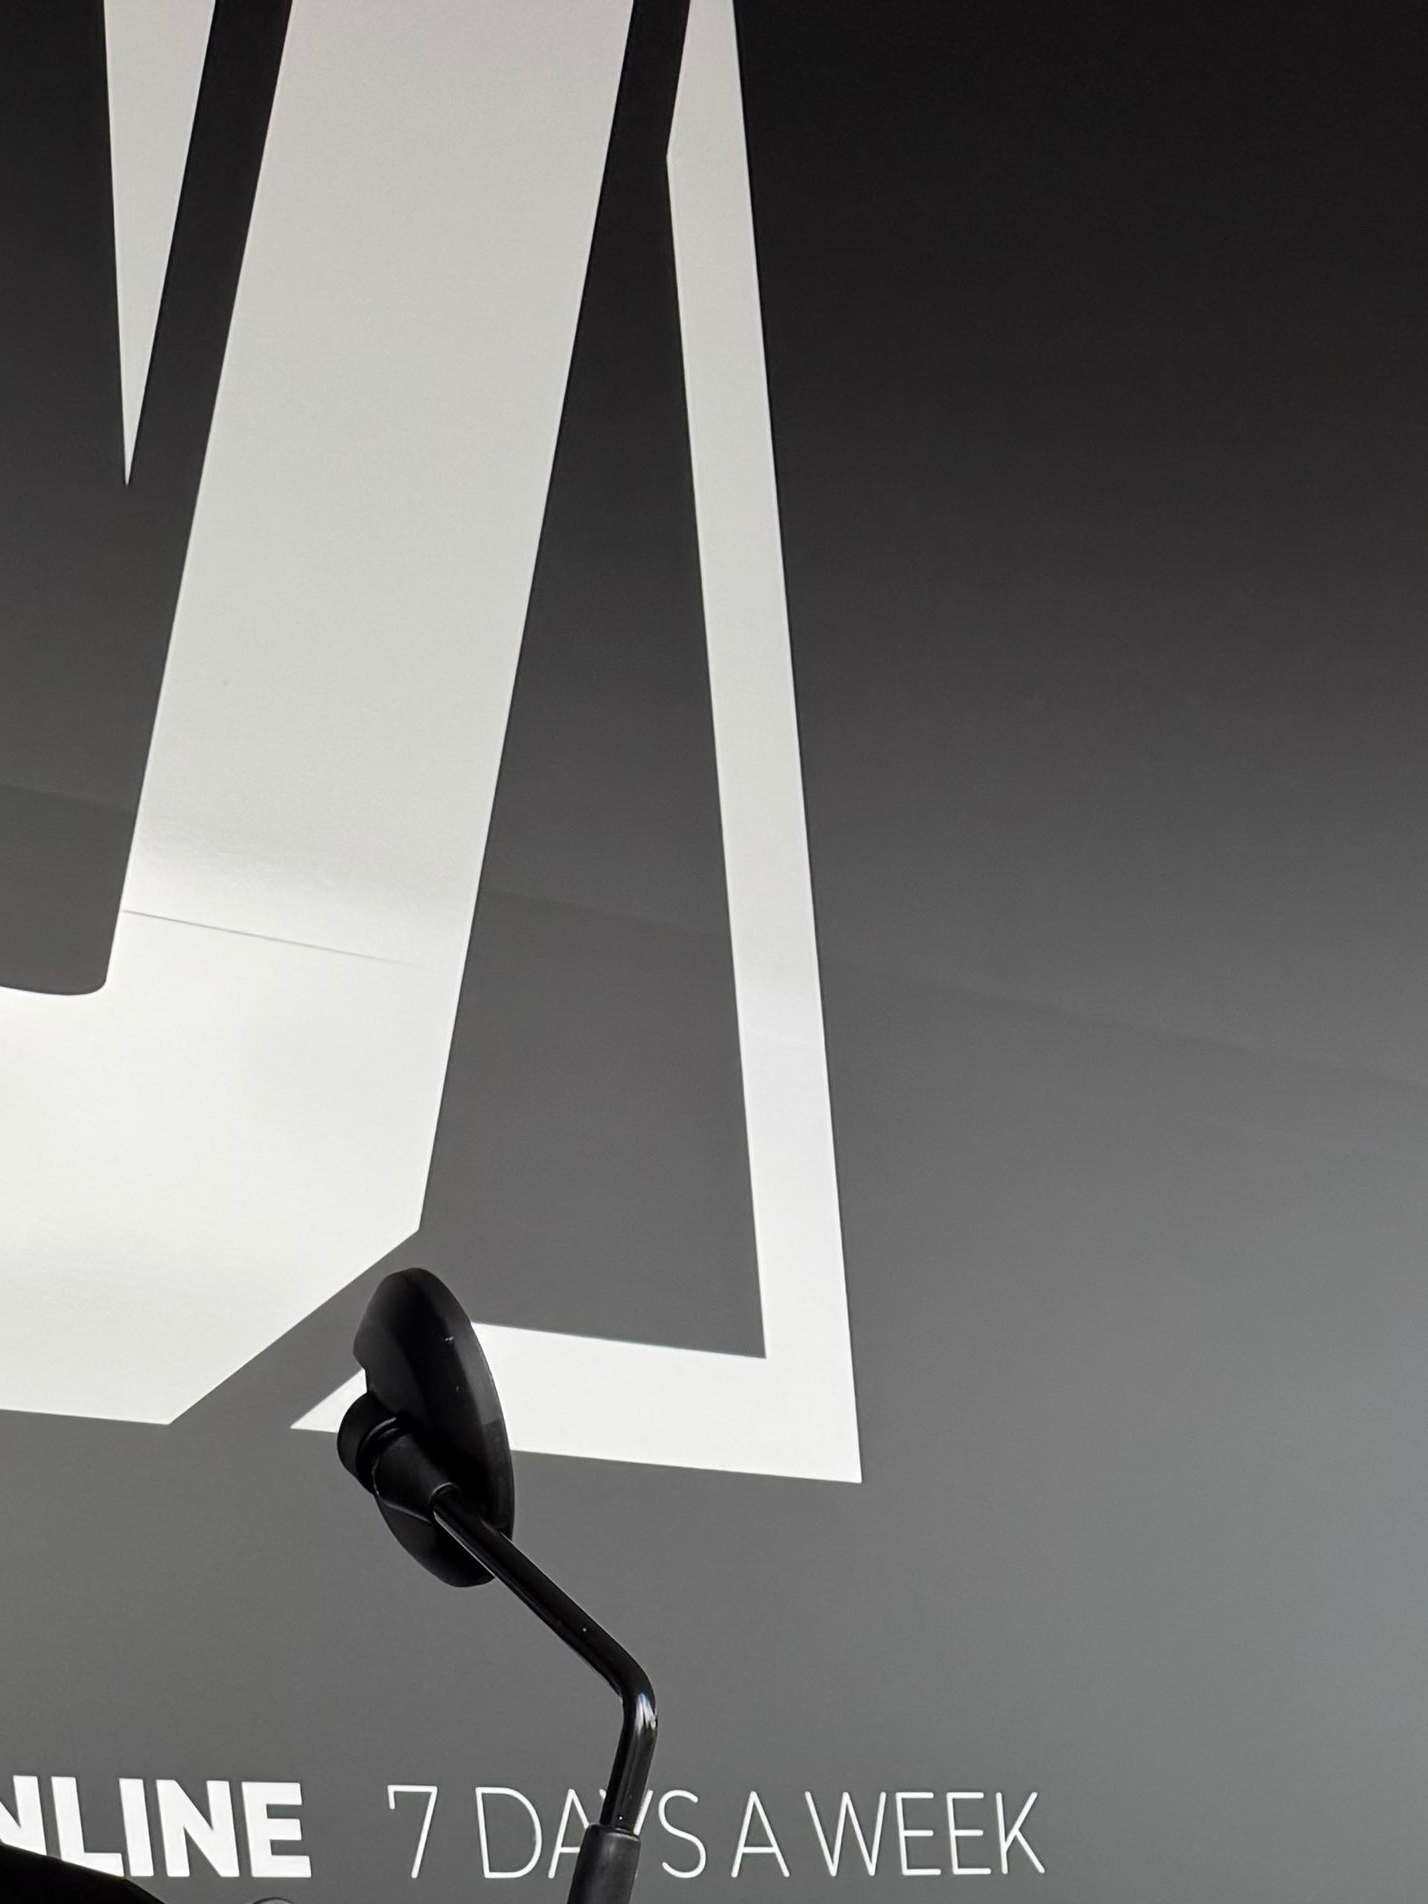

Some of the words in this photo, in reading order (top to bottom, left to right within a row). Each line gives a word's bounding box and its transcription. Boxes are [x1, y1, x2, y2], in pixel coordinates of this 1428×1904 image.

[387, 1785, 438, 1879] 7
[731, 1791, 790, 1878] A
[805, 1791, 1046, 1877] WEEK
